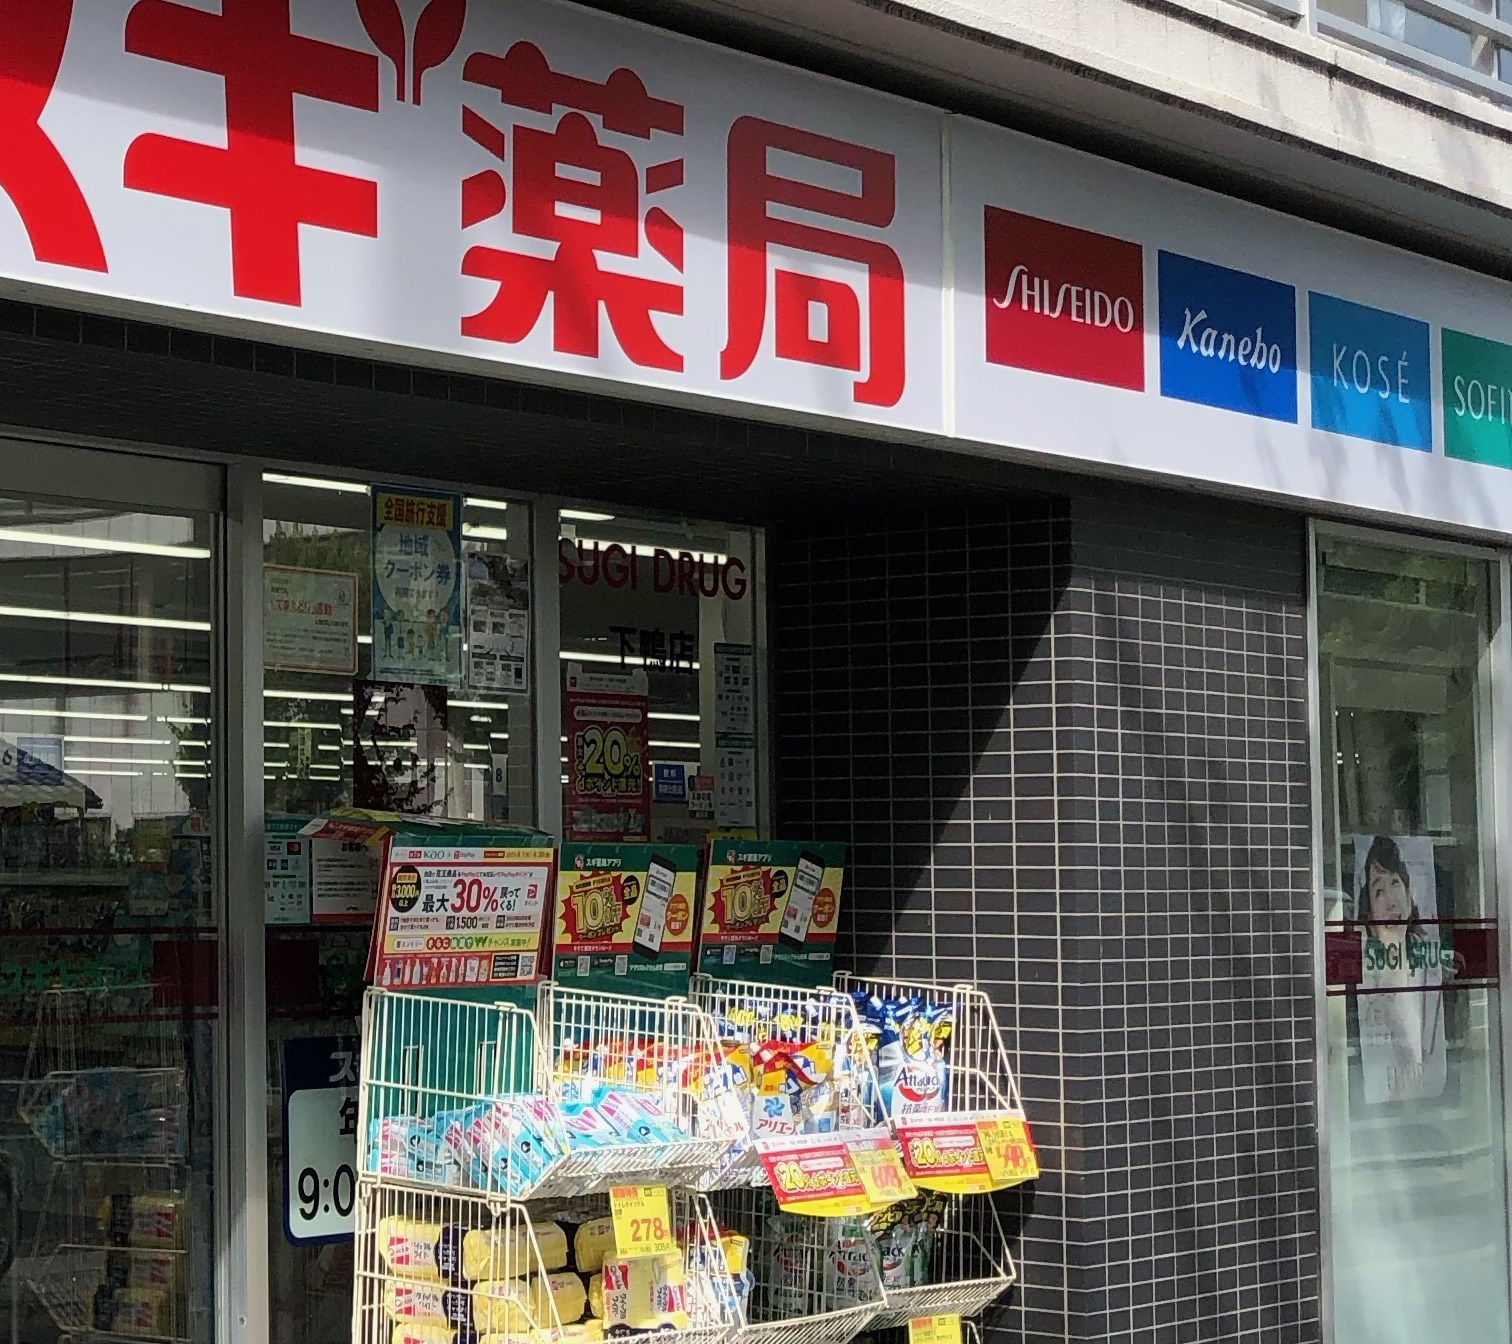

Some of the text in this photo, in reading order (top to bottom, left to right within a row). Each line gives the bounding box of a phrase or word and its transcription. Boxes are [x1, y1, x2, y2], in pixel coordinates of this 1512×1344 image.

[993, 265, 1134, 333] SHISEIDO
[1177, 307, 1281, 375] Kanebo
[1332, 343, 1410, 404] KOSÉ
[399, 533, 429, 557] 地域
[384, 560, 451, 586] クーポン券
[558, 538, 748, 602] SUGI DRUG
[609, 626, 695, 676] 下鴨店
[422, 893, 450, 914] 最大
[450, 878, 499, 914] 30%
[1365, 938, 1402, 971] SUGI
[328, 1051, 360, 1083] ス
